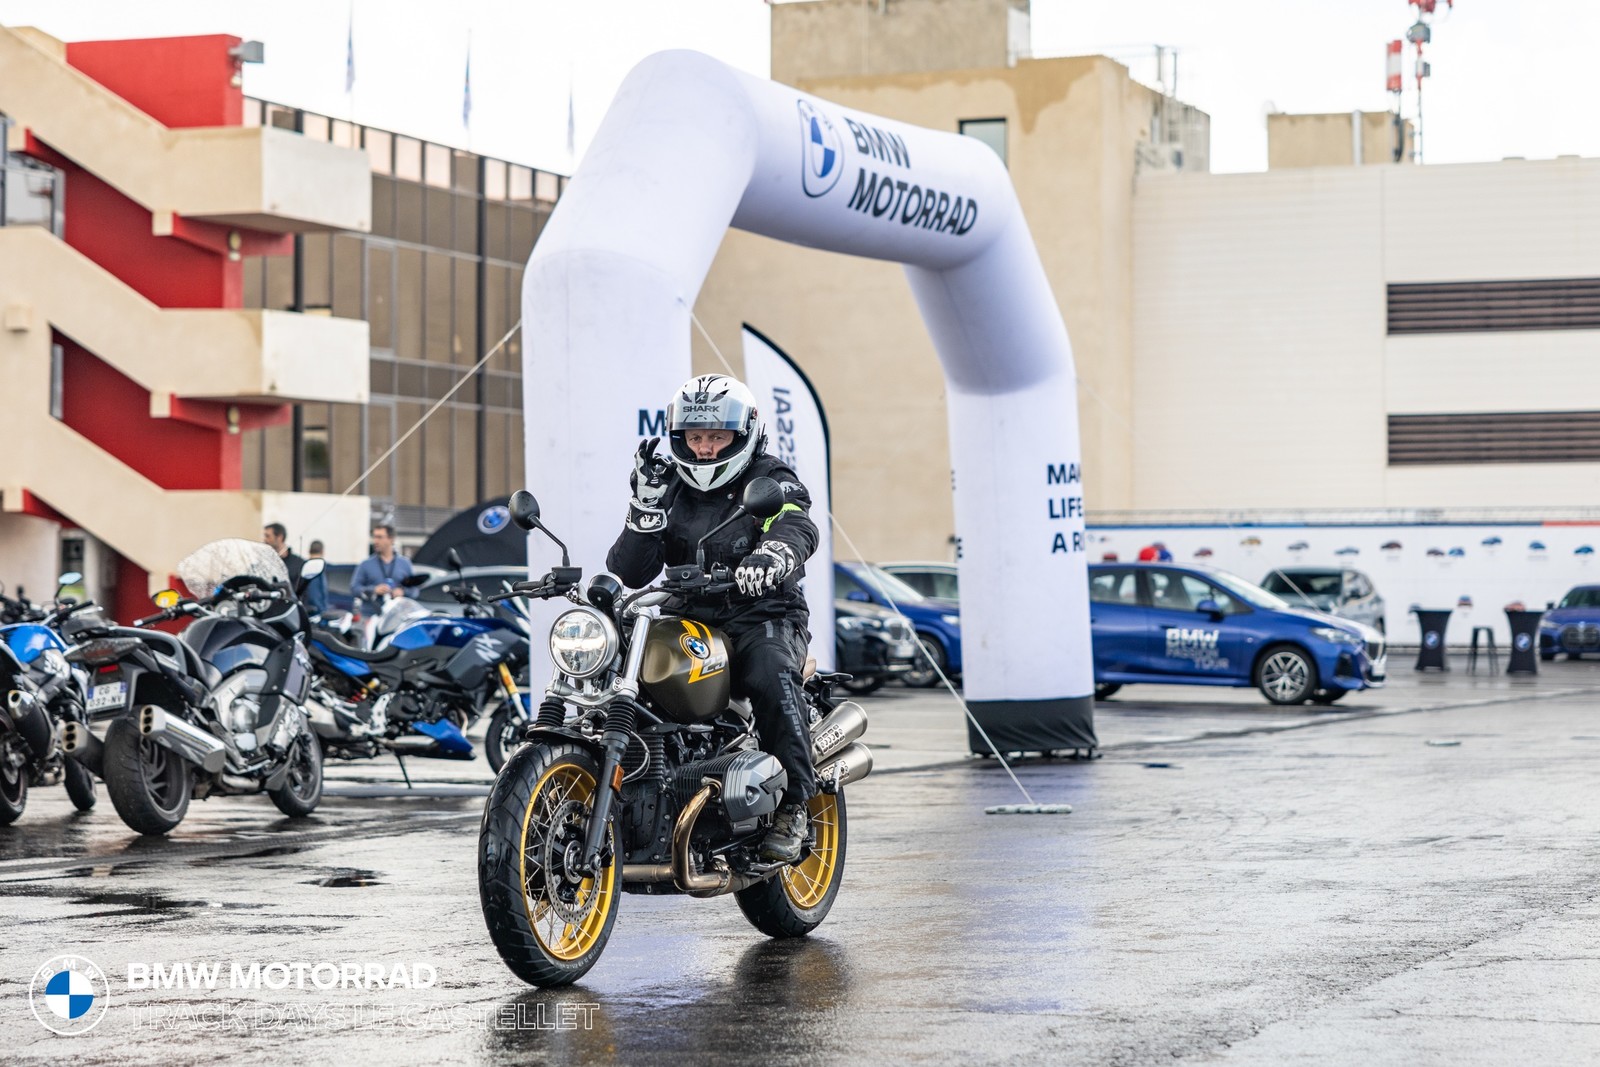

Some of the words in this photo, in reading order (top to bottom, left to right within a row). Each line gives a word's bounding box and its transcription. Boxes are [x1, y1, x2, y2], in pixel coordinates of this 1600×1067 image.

[843, 117, 910, 169] BMW
[847, 168, 977, 236] MOTORRAD
[683, 405, 720, 413] SHARK
[1047, 463, 1081, 485] MA
[1052, 532, 1067, 554] A
[1166, 628, 1220, 648] BMW
